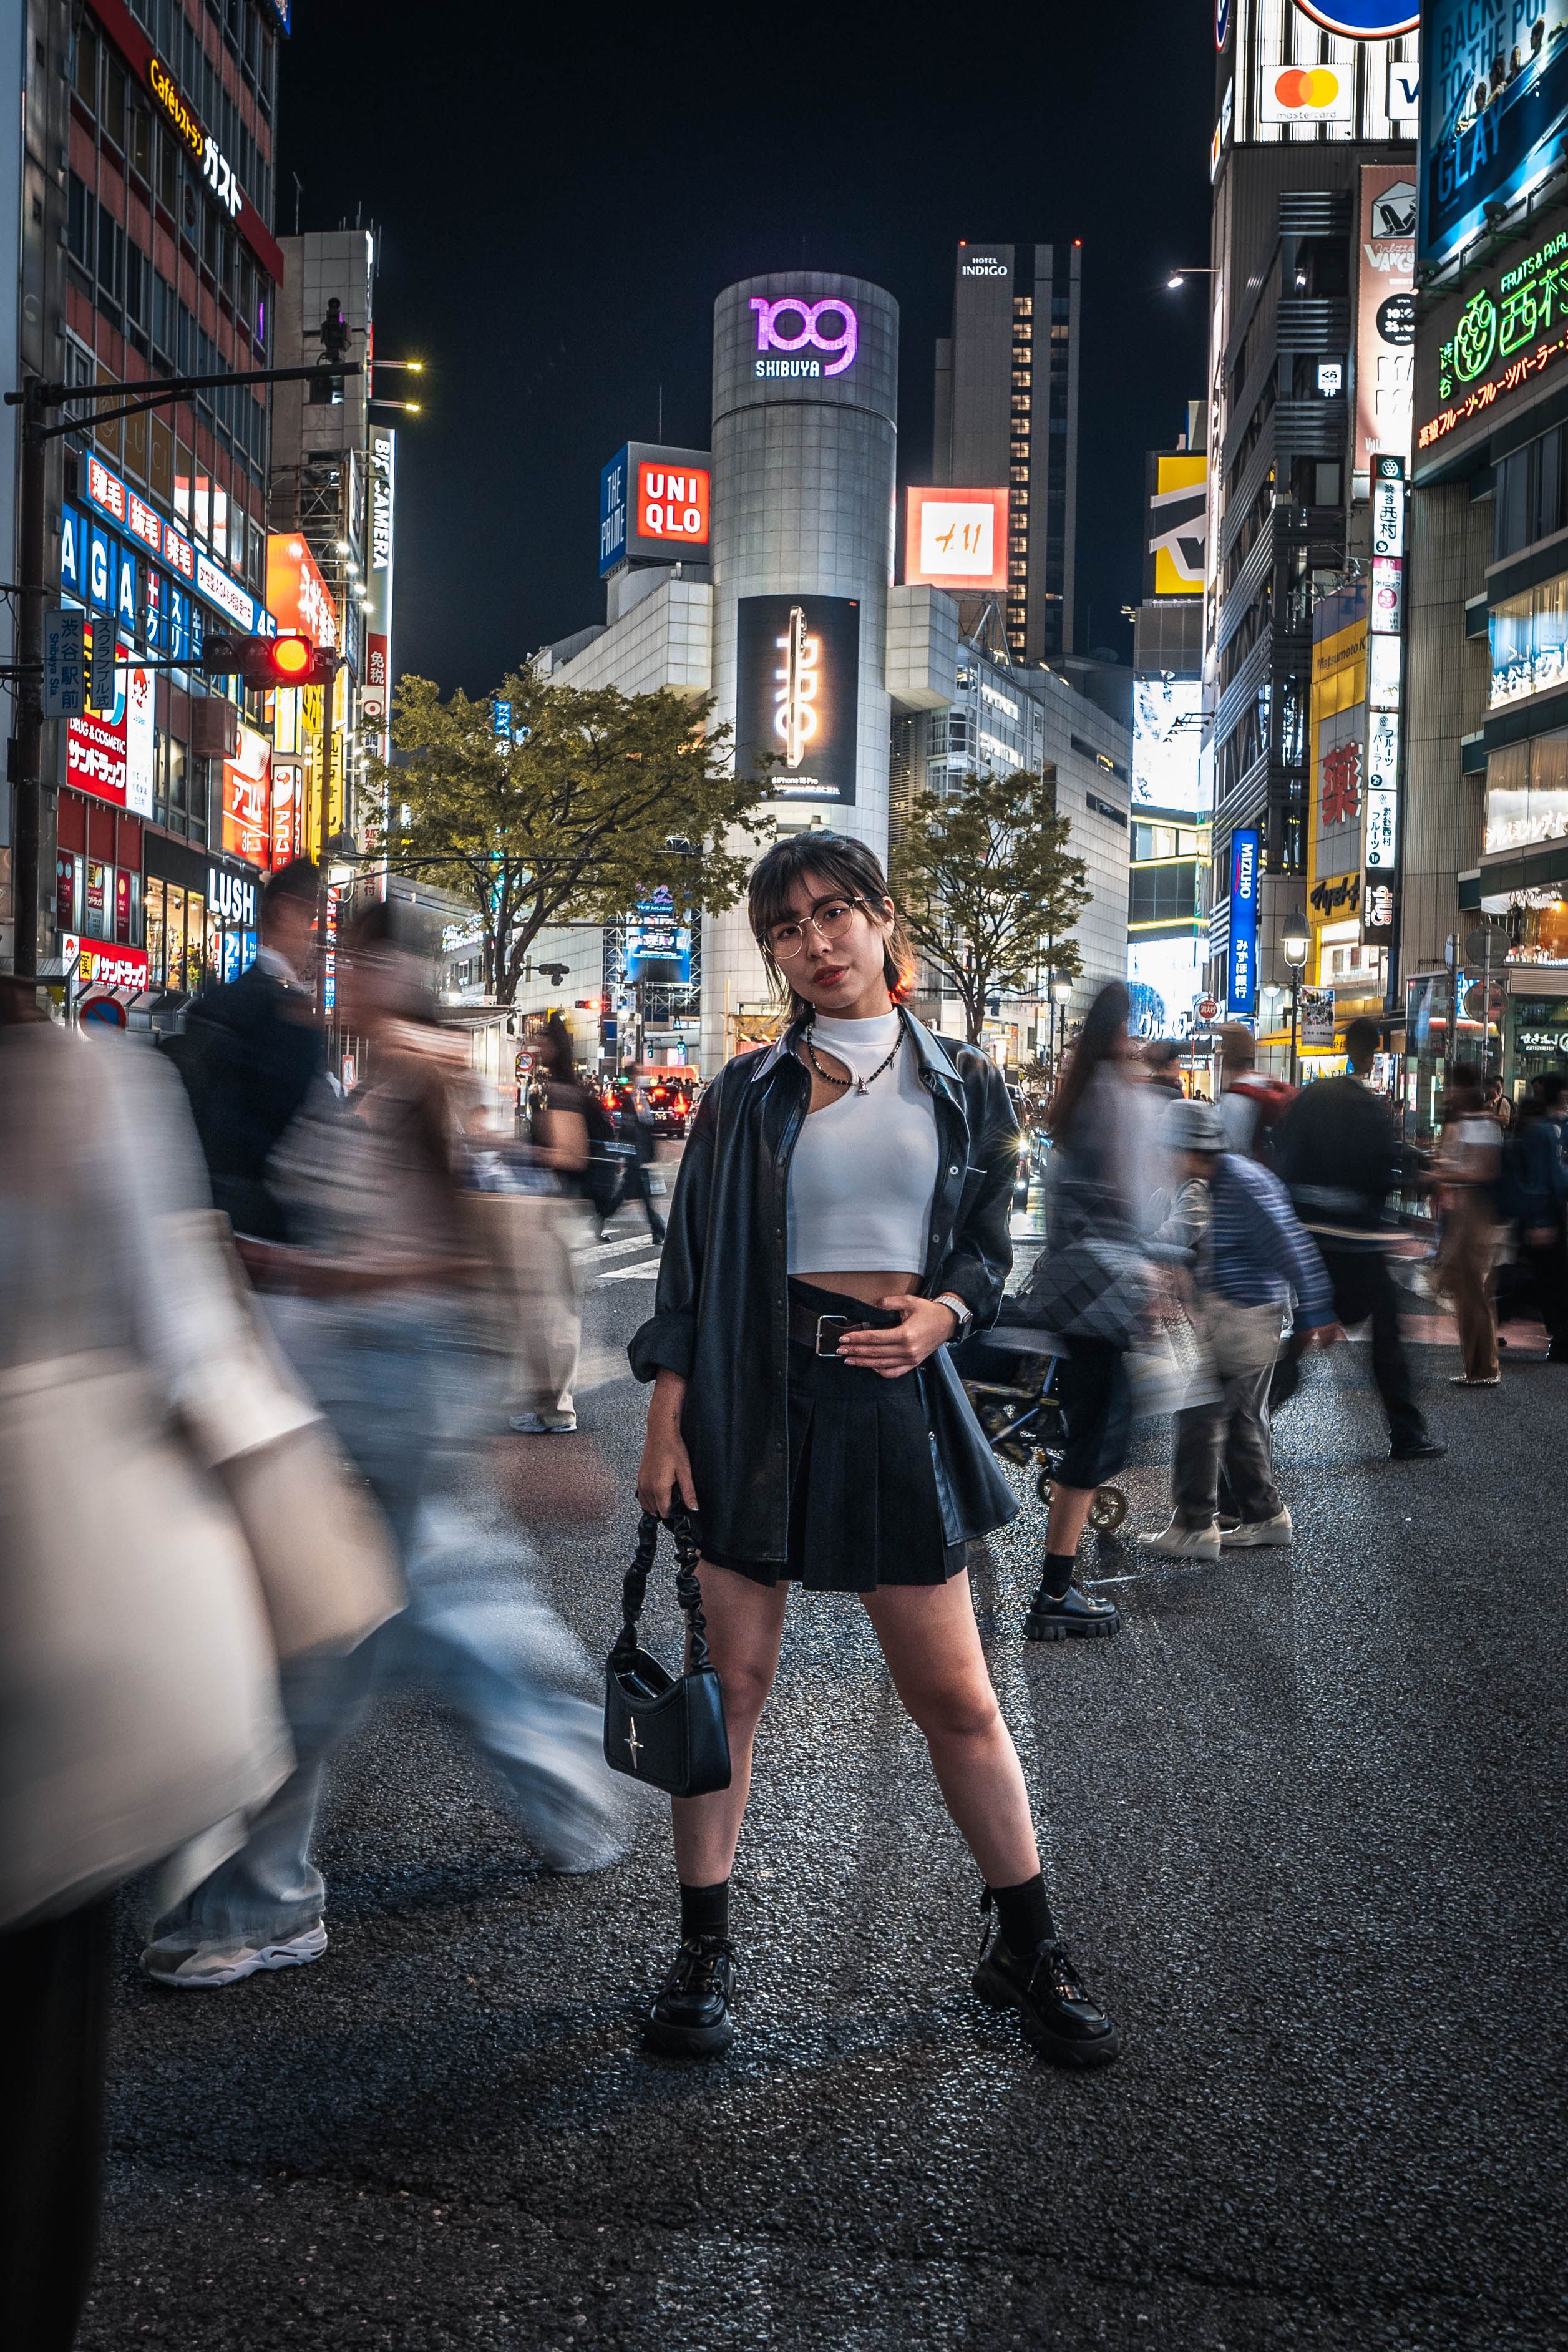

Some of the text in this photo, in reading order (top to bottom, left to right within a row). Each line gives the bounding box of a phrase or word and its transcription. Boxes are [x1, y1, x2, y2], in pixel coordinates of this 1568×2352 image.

[1441, 61, 1462, 115] TO
[1469, 14, 1506, 76] THE
[1438, 99, 1503, 202] GLAY
[204, 136, 242, 217] ガスト
[962, 266, 1008, 275] INDIGO
[749, 297, 858, 376] 109
[756, 360, 819, 377] SHIBUYA
[608, 466, 621, 513] THE
[646, 472, 696, 504] UNI
[1380, 483, 1397, 539] 渋谷西村
[373, 479, 391, 569] CAMERA
[601, 504, 625, 560] PRIME
[645, 503, 701, 534] QLO
[61, 519, 134, 620] AGA
[50, 633, 59, 698] Shibuya Sta.
[61, 618, 79, 708] 渋谷駅前
[370, 651, 384, 685] 免税
[69, 718, 89, 737] DRUG
[95, 728, 126, 754] COSMETIC
[1373, 734, 1382, 771] パーラー
[1385, 730, 1394, 766] フルーツ
[69, 738, 126, 788] サンドラッグ
[232, 774, 262, 823] アコム
[275, 811, 290, 852] アコム
[1371, 812, 1380, 849] フルーツ
[1240, 843, 1253, 899] MIZUHO
[209, 868, 255, 925] LUSH
[1371, 886, 1393, 926] HUB
[100, 957, 147, 987] サンドラッグ
[225, 933, 248, 964] 24
[1235, 940, 1248, 998] みずほ銀行
